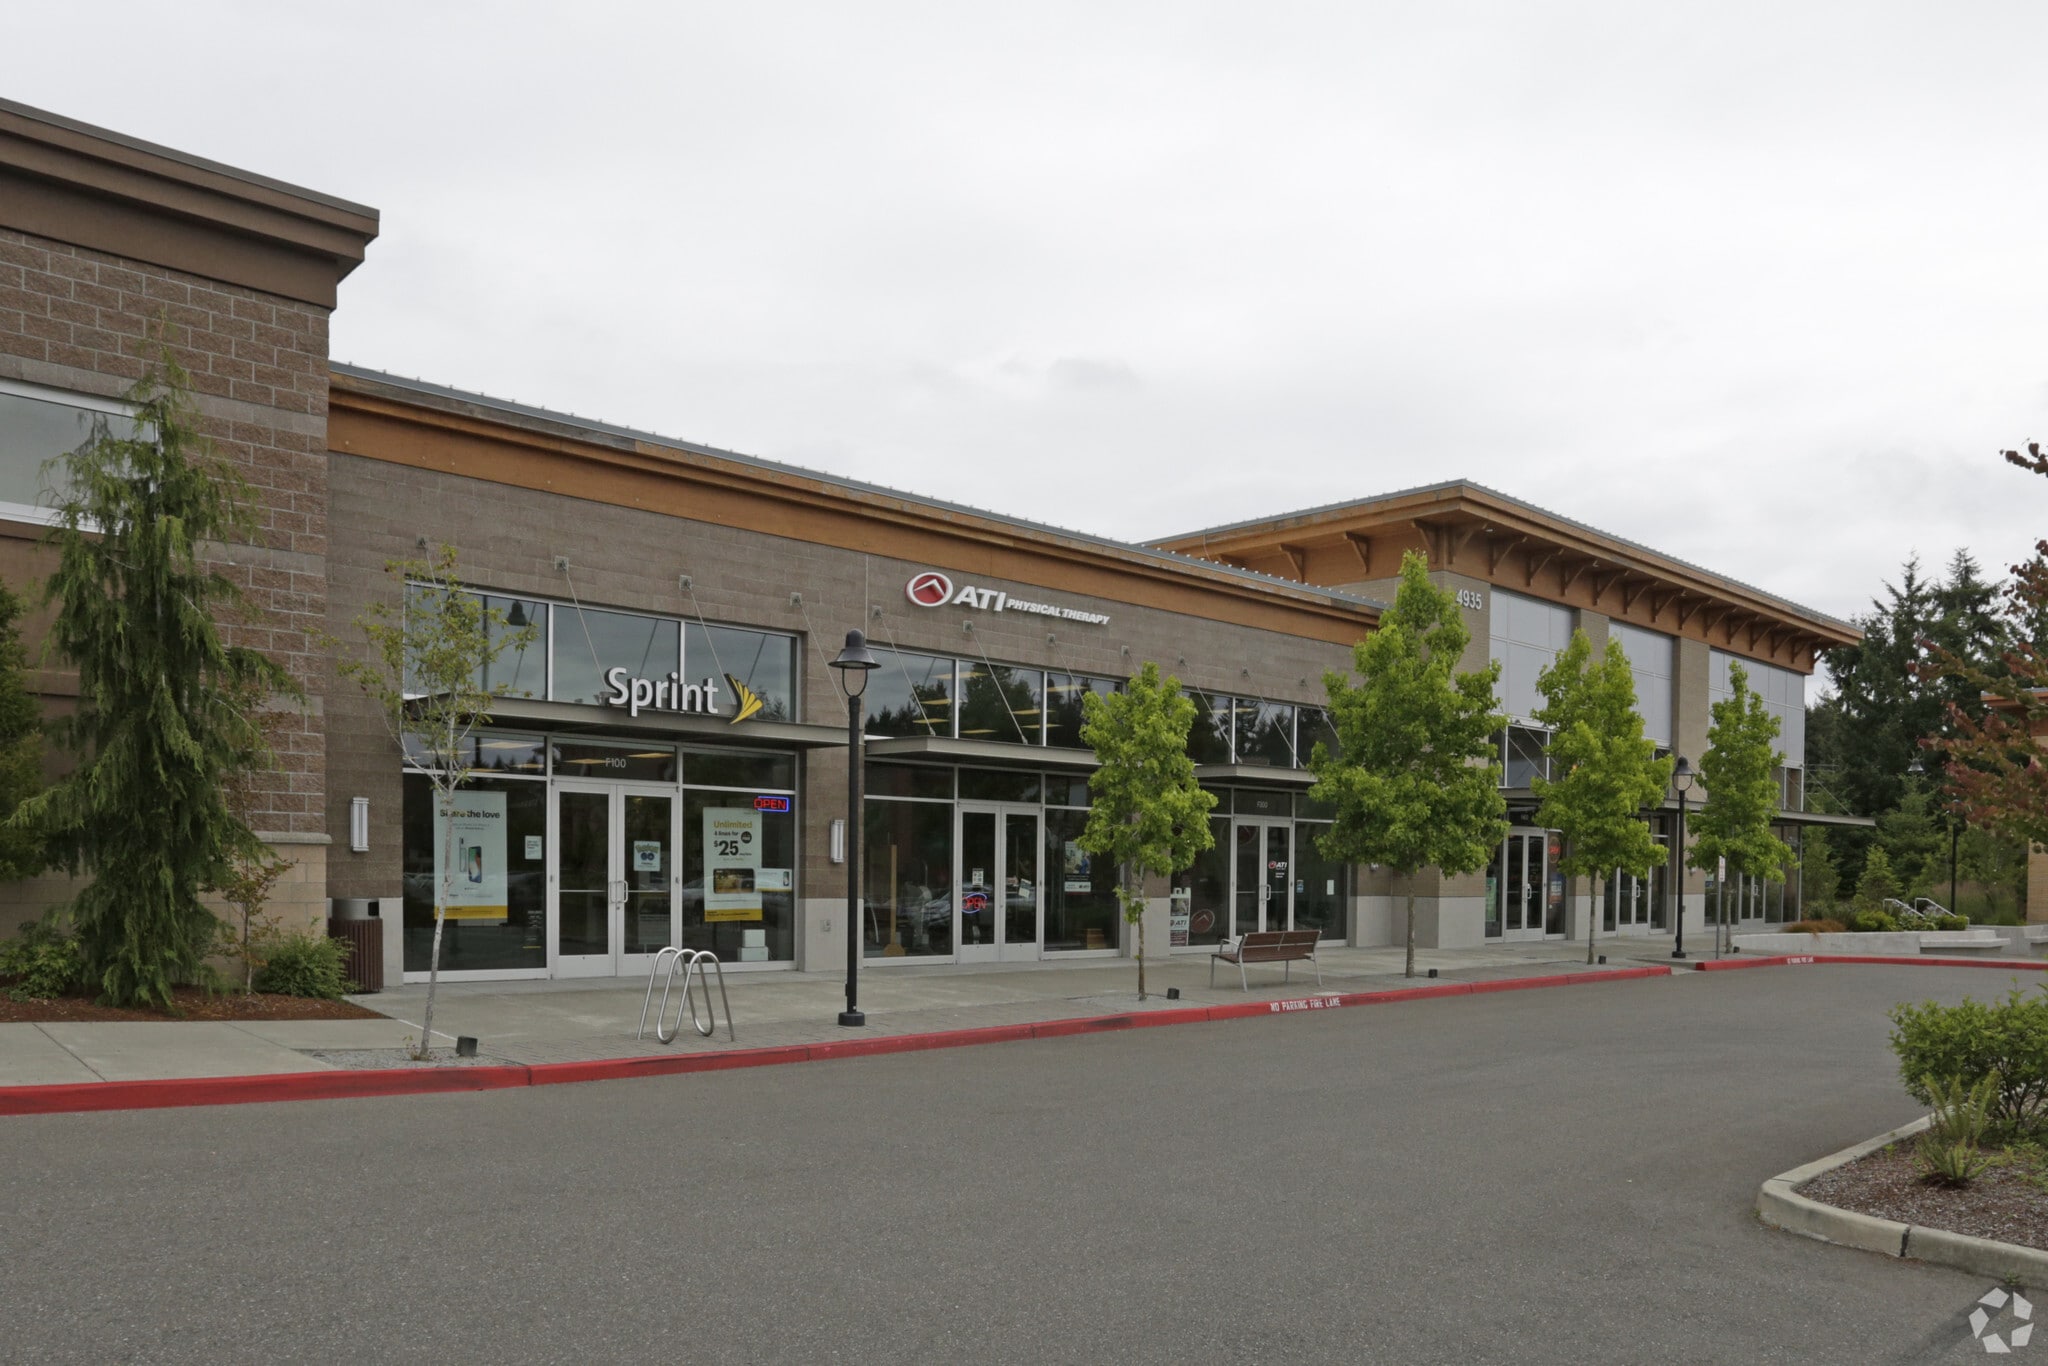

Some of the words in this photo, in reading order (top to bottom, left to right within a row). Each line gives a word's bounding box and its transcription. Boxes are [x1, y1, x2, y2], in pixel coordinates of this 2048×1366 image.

[952, 586, 1006, 611] ATI
[1006, 598, 1061, 617] PHYSICAL
[1062, 608, 1110, 625] THERAPY
[1456, 589, 1482, 610] 4935
[607, 667, 719, 717] Sprint
[605, 757, 627, 768] F100
[754, 798, 787, 810] OPEN
[466, 810, 481, 818] the
[482, 810, 500, 819] love
[713, 820, 752, 829] Unlimited
[713, 840, 739, 856] $25
[960, 896, 987, 910] OPEN
[1270, 1002, 1280, 1012] NO
[1282, 1000, 1308, 1011] PARKING
[1310, 998, 1324, 1009] FIRE
[1325, 997, 1341, 1007] LANE
